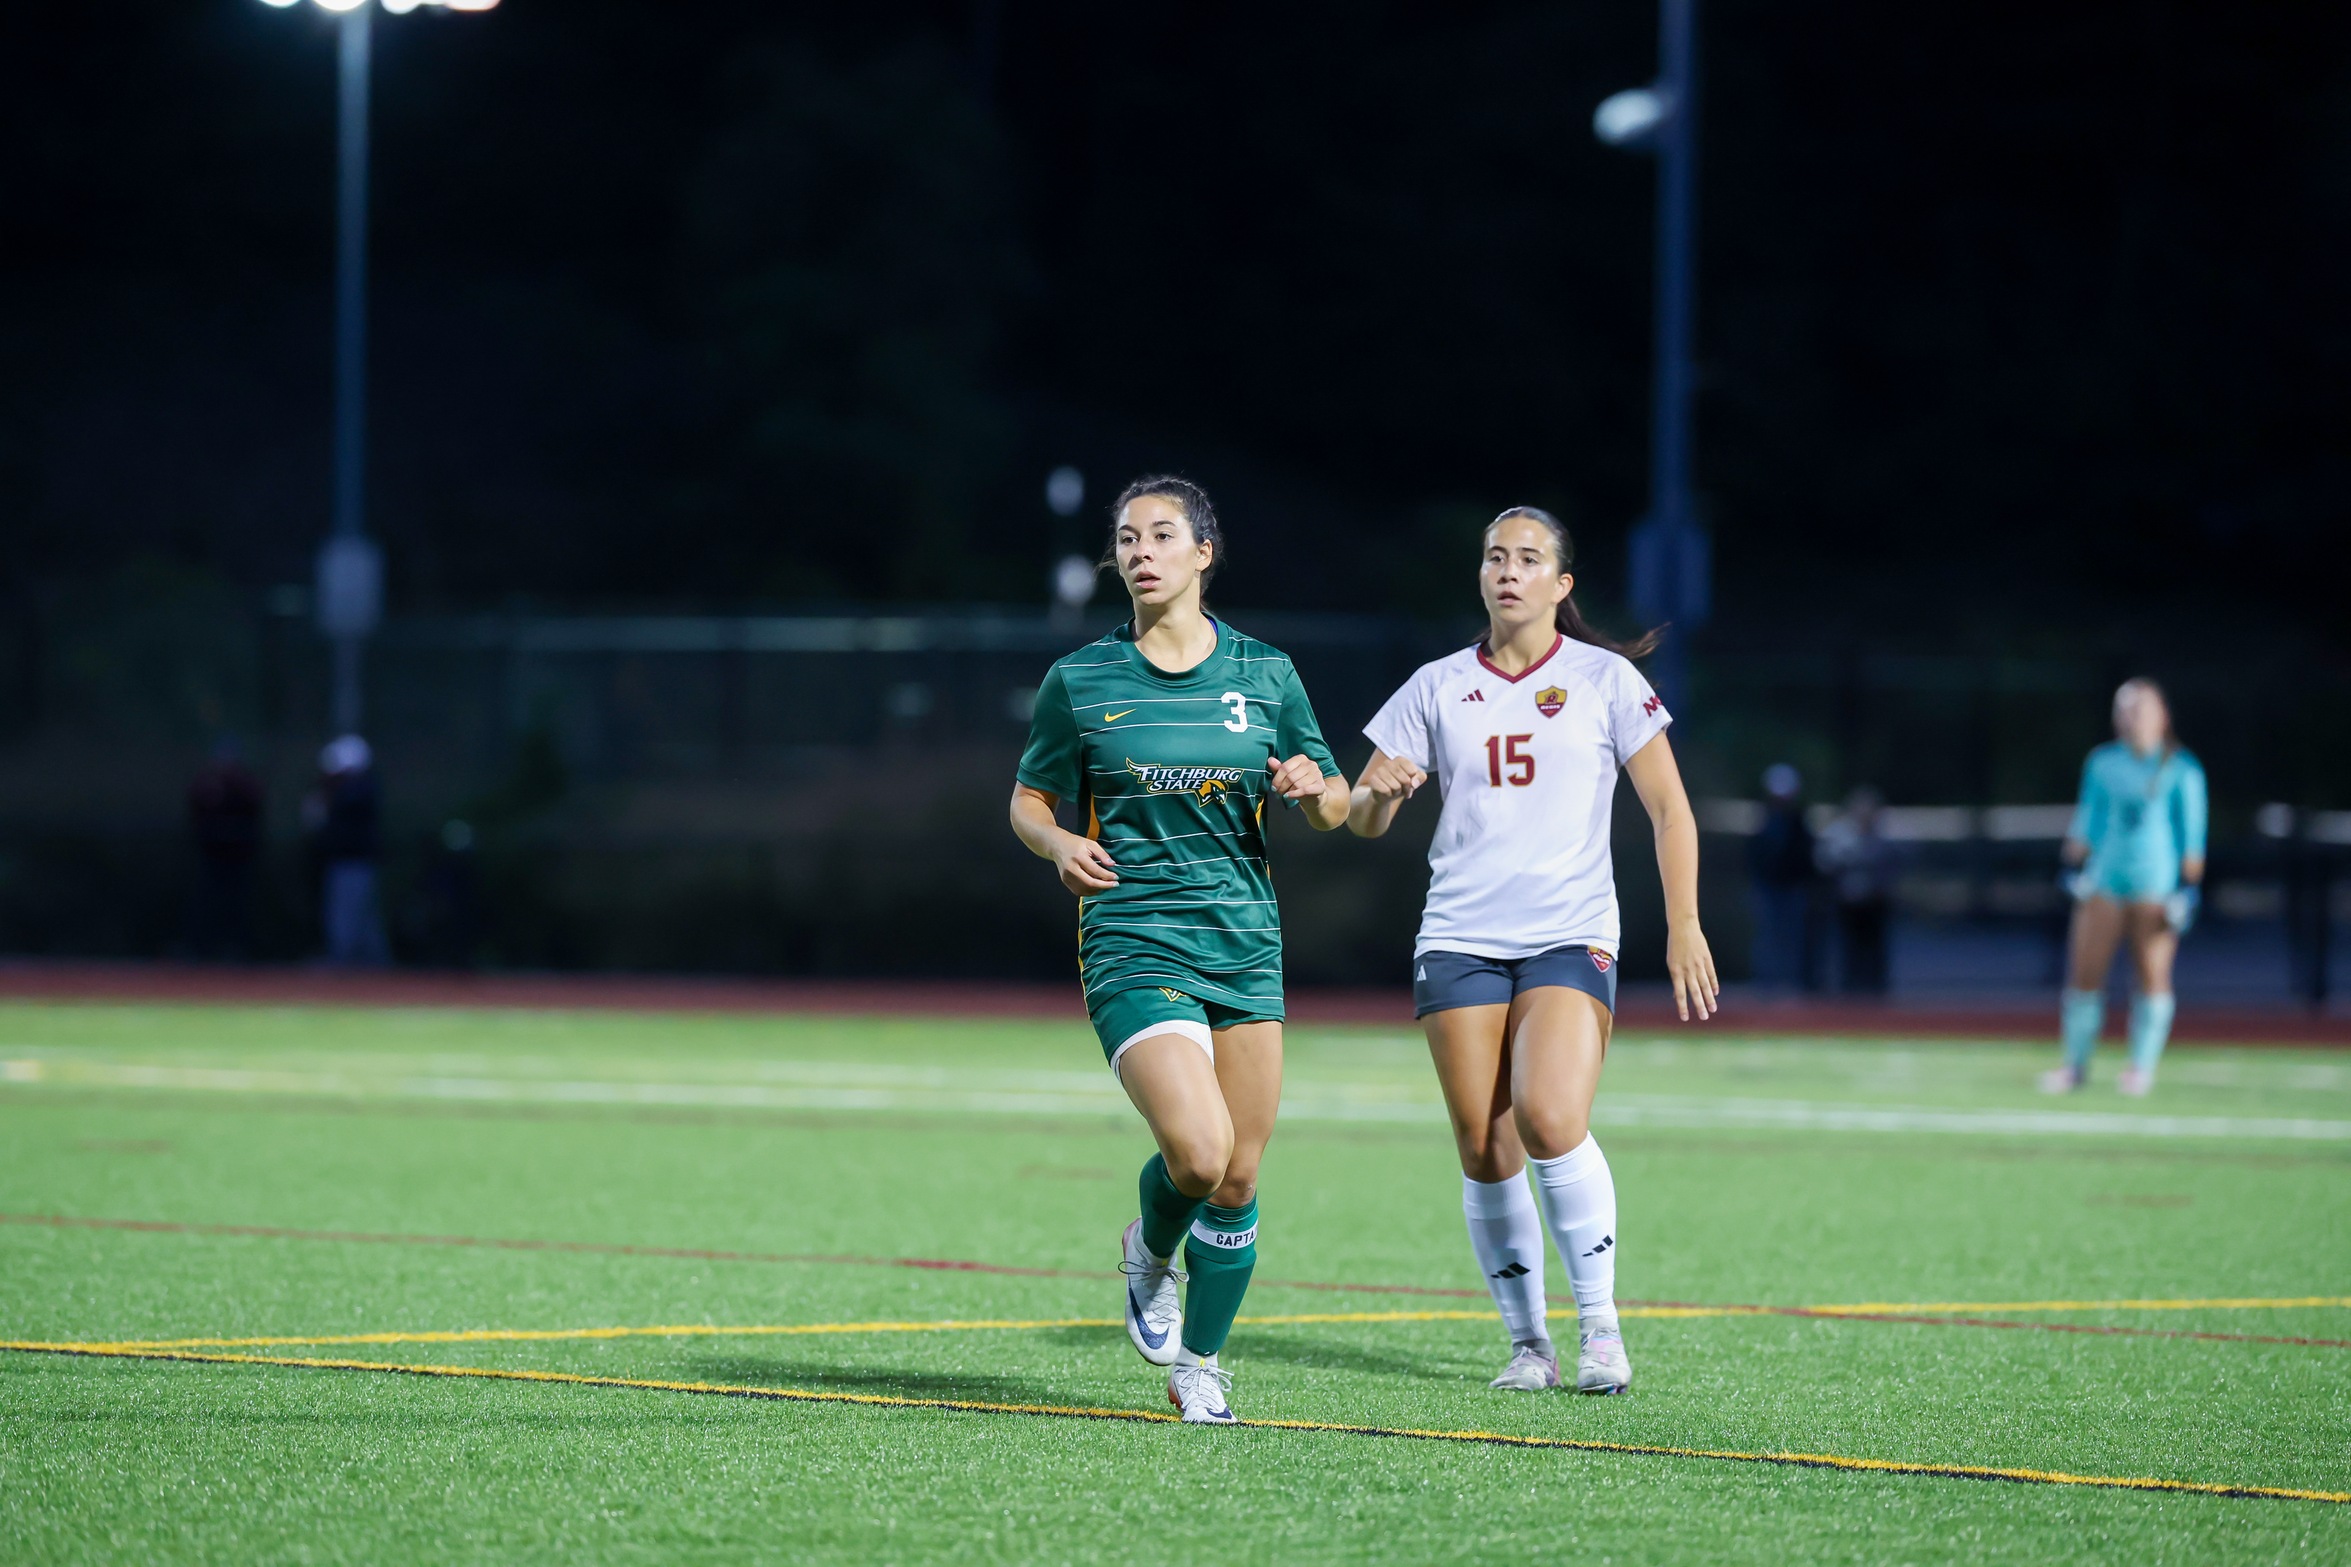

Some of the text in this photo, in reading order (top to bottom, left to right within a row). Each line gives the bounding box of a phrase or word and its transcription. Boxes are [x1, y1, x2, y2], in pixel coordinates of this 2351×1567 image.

[1220, 691, 1248, 733] 3
[1129, 763, 1242, 782] FITCHBURG
[1484, 732, 1536, 788] 15
[1149, 779, 1206, 792] STATE
